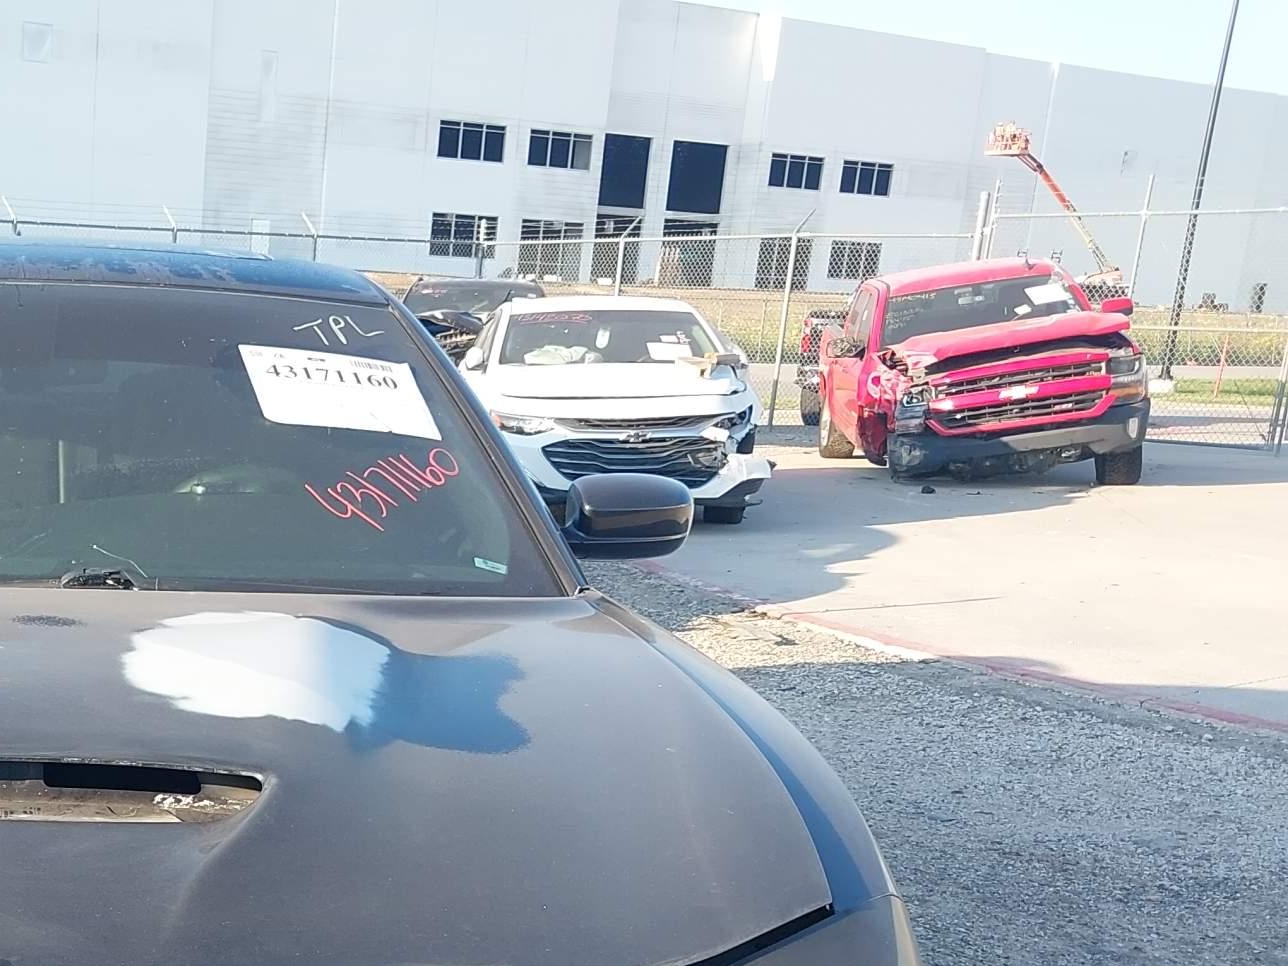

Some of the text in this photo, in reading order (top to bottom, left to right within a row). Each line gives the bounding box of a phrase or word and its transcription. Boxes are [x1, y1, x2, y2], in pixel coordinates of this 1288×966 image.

[293, 315, 384, 345] TPL
[266, 363, 399, 390] 43171160
[304, 448, 460, 532] 43171160
